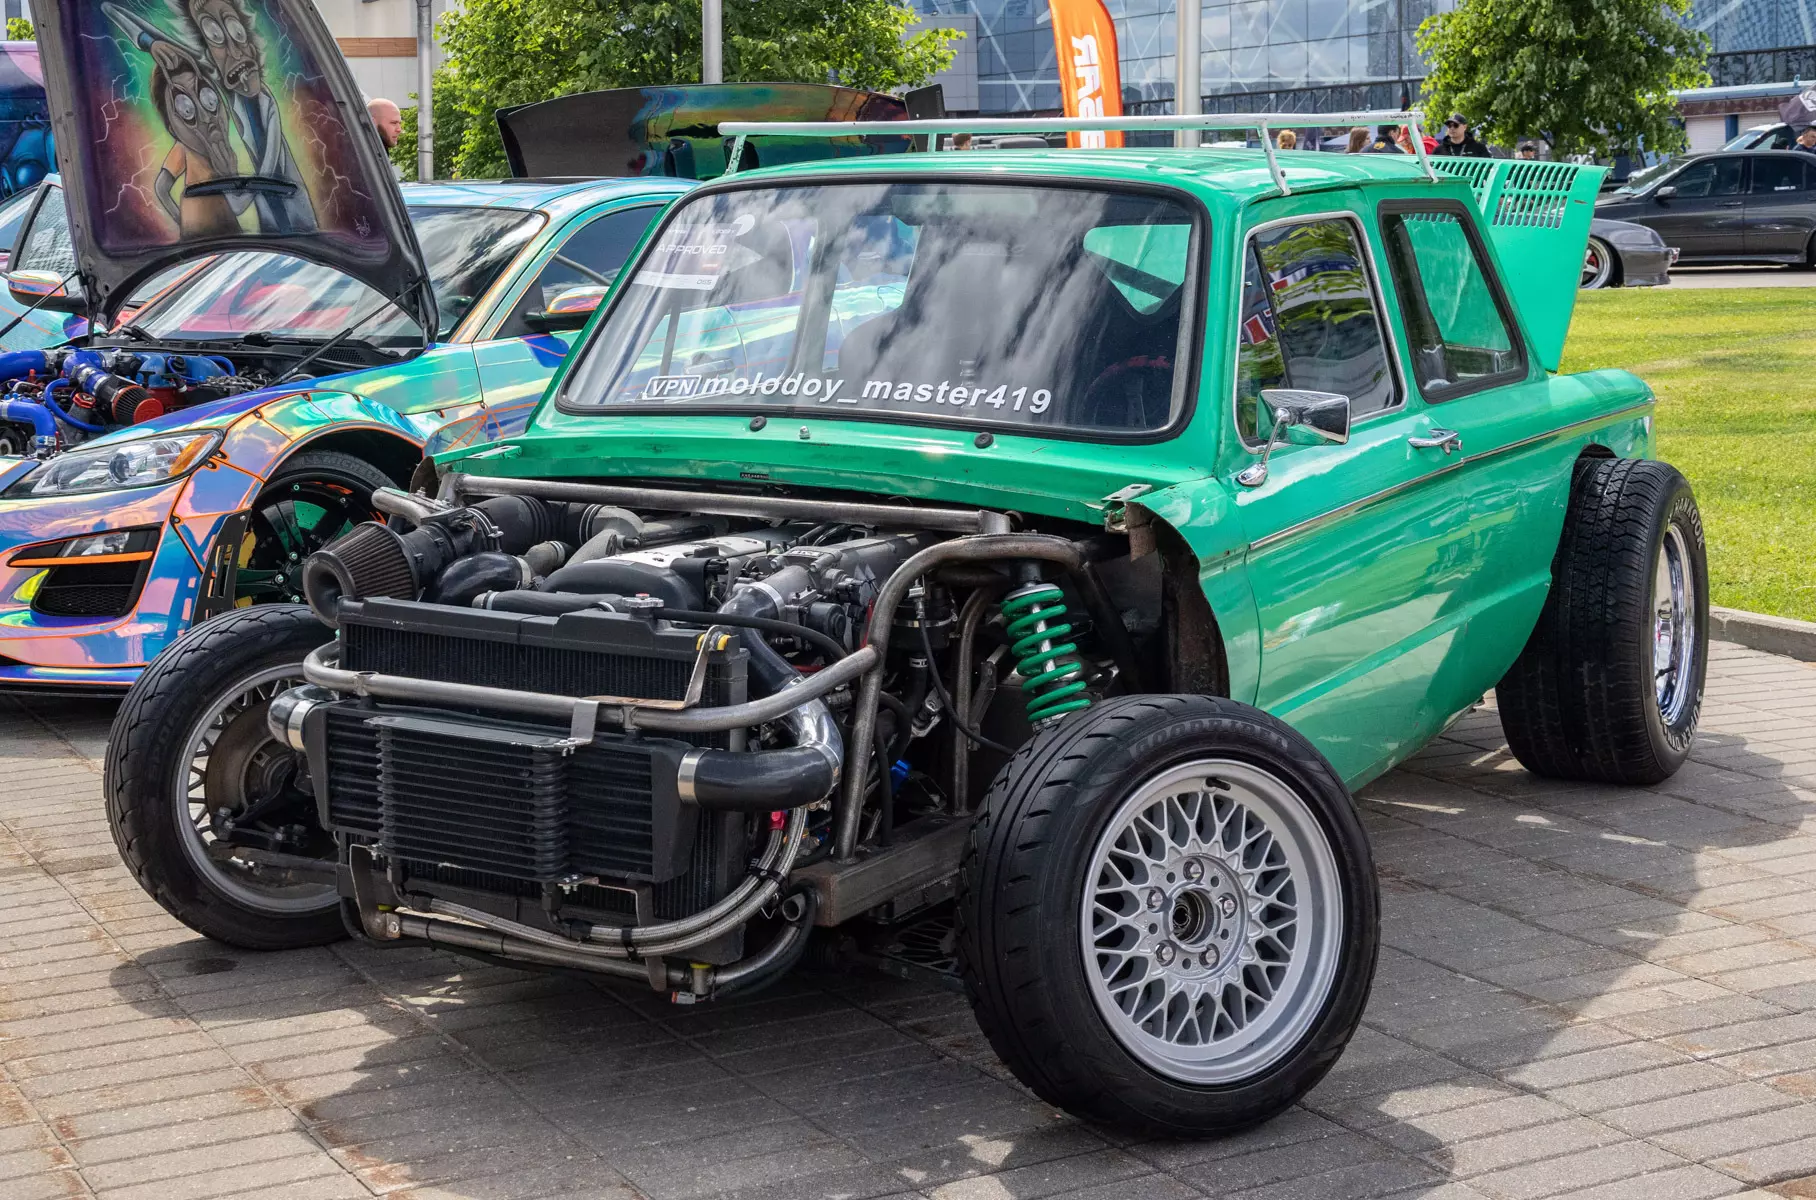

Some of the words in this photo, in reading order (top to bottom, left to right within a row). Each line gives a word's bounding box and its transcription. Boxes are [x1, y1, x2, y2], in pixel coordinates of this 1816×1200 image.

[655, 243, 728, 255] APPROVED
[651, 378, 696, 397] VPN
[701, 372, 1052, 414] molodoy_master419
[1673, 497, 1705, 551] HANKOOK
